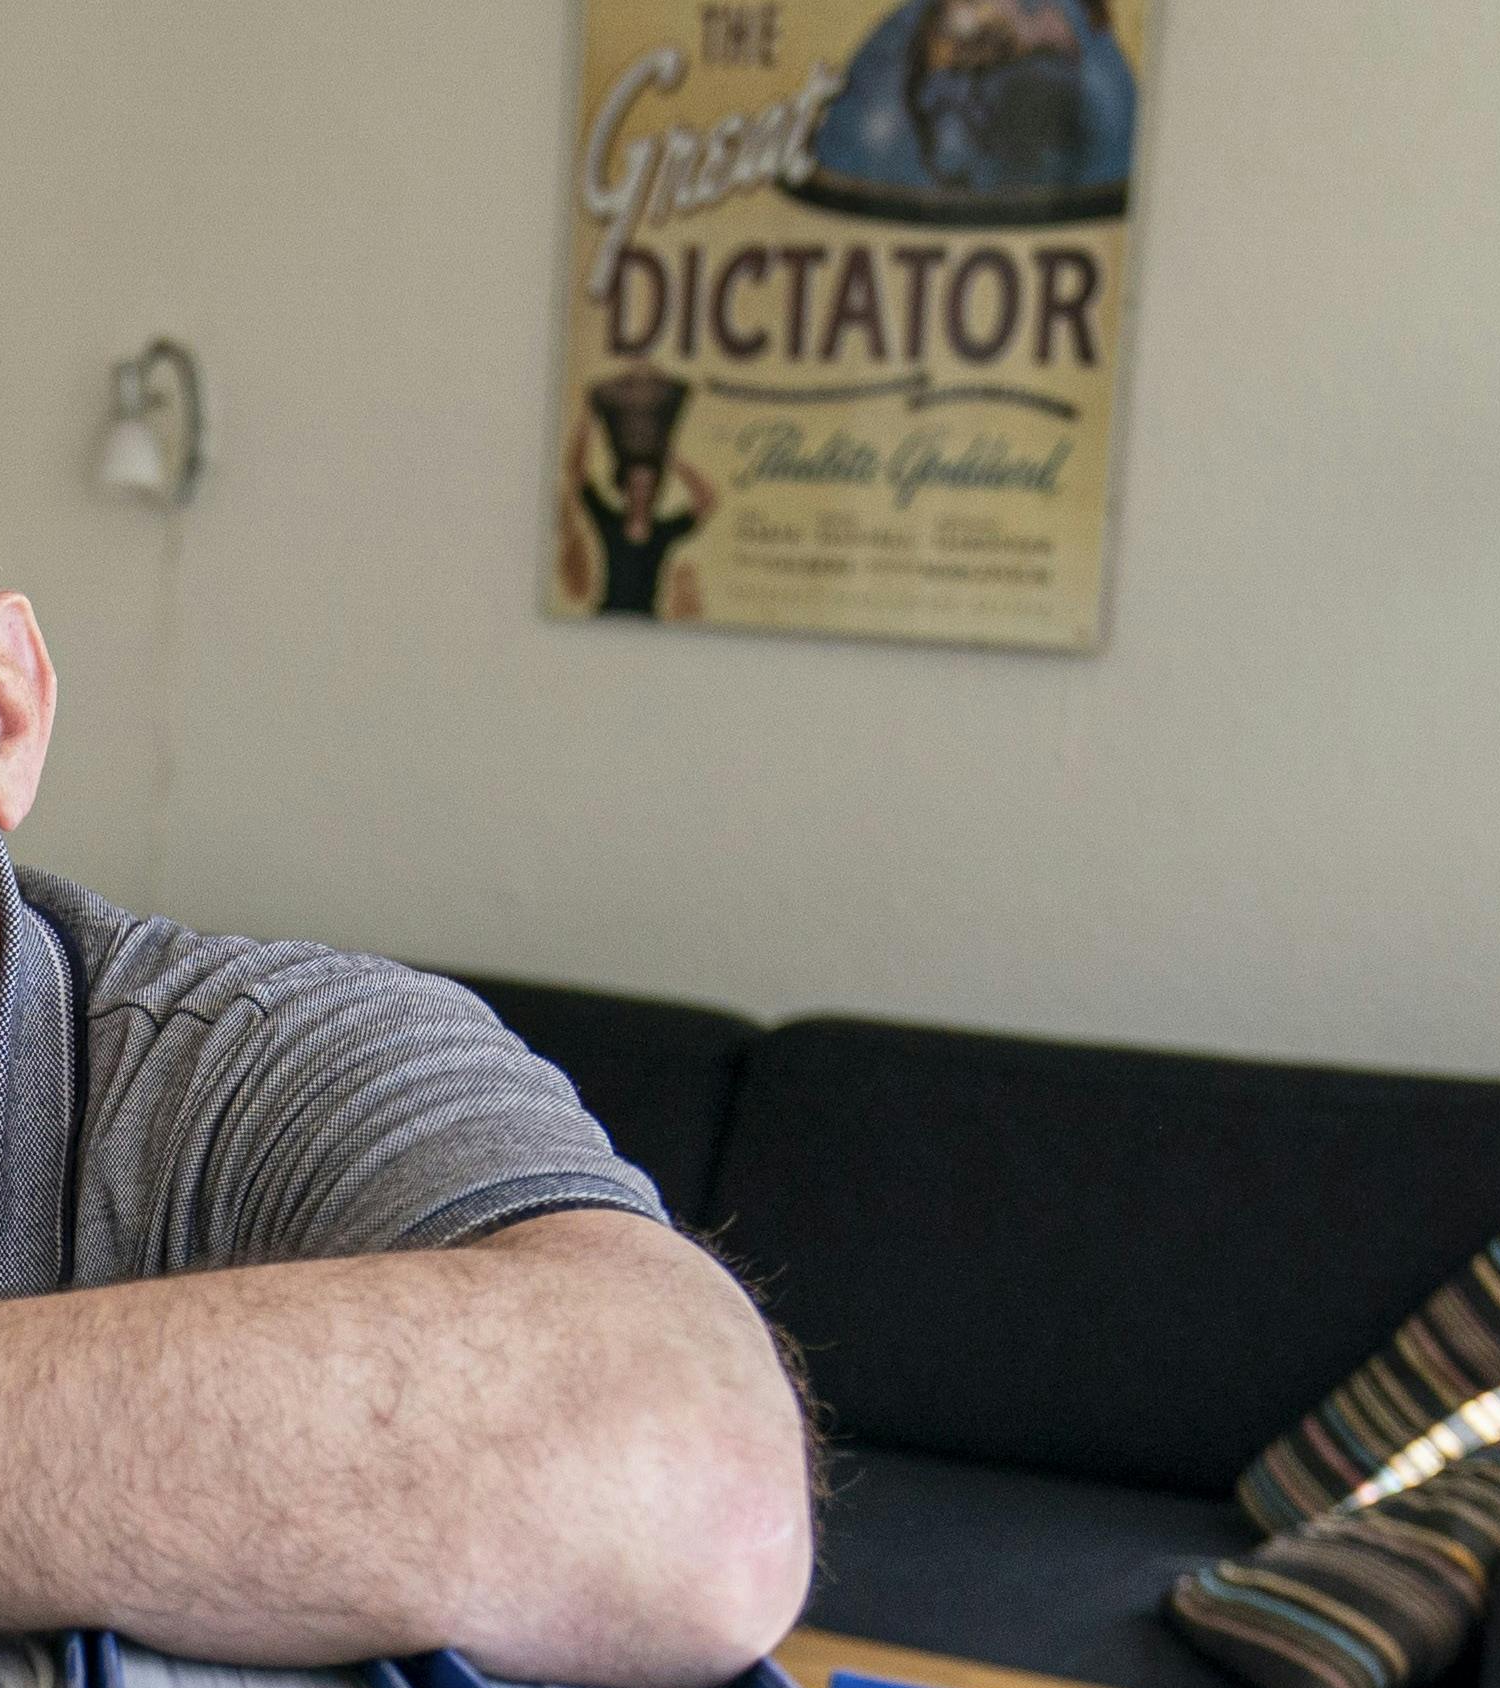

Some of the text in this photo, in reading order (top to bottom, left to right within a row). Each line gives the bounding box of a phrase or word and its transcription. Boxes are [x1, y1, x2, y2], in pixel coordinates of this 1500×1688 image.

[703, 4, 776, 68] THE
[587, 46, 843, 298] Great
[606, 243, 1099, 366] DICTATOR
